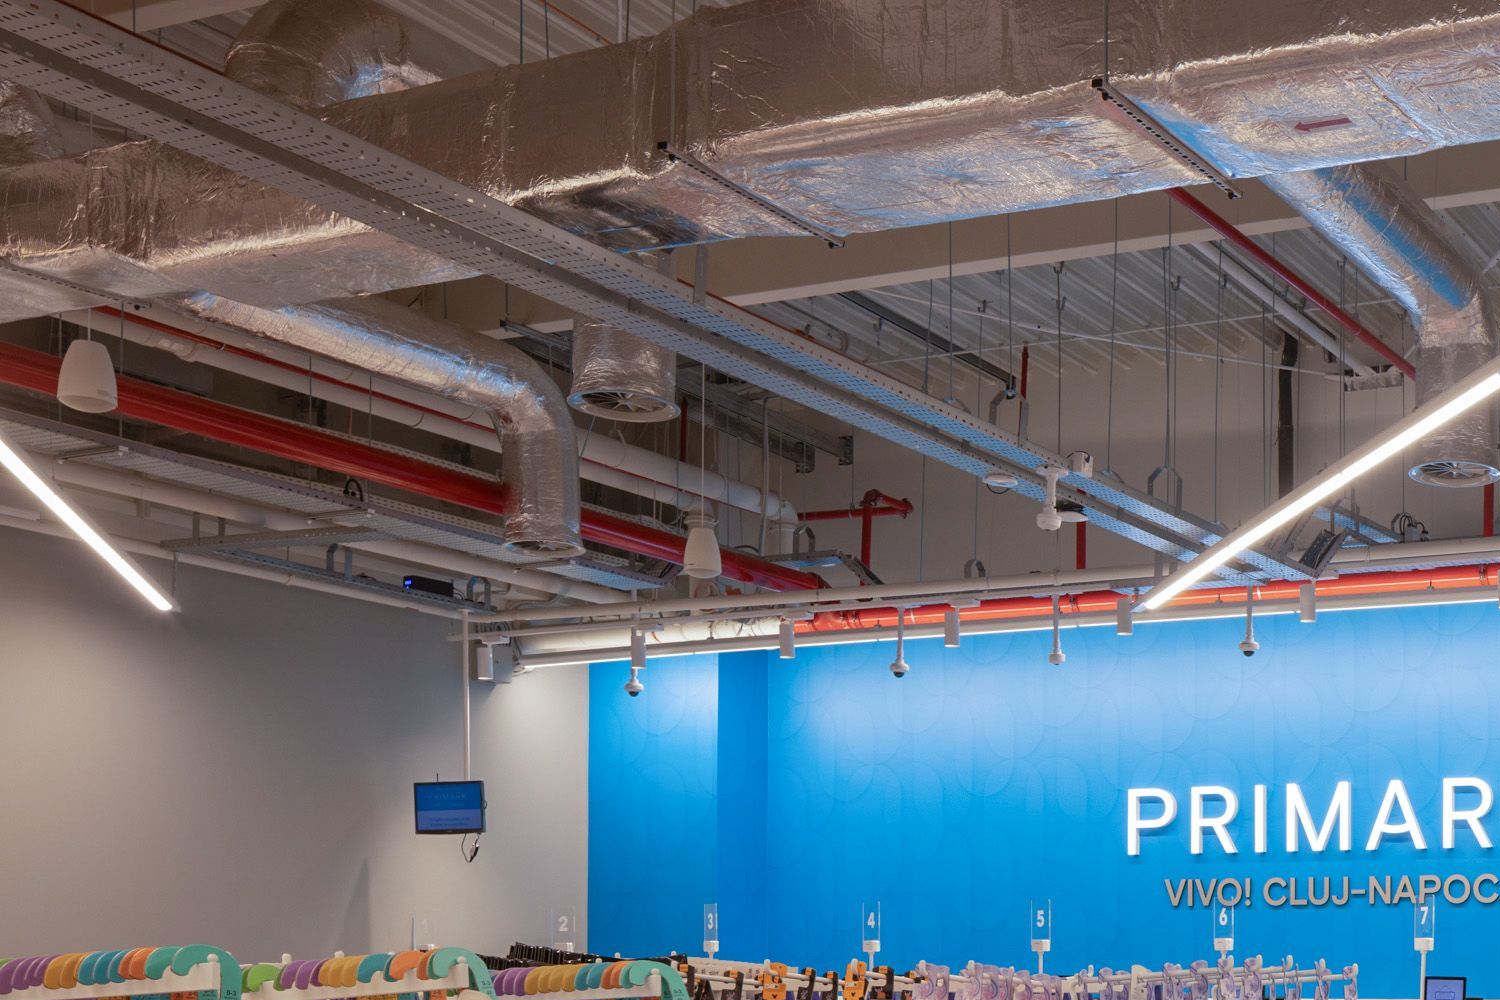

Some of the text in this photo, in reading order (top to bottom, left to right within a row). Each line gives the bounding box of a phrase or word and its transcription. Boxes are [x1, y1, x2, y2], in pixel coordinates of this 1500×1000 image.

[1165, 877, 1252, 907] VIVO!
[558, 915, 569, 932] 2
[707, 913, 714, 929] 3
[867, 911, 876, 929] 4
[1036, 909, 1045, 928] 5
[1218, 907, 1228, 926] 6
[1420, 906, 1429, 925] 7
